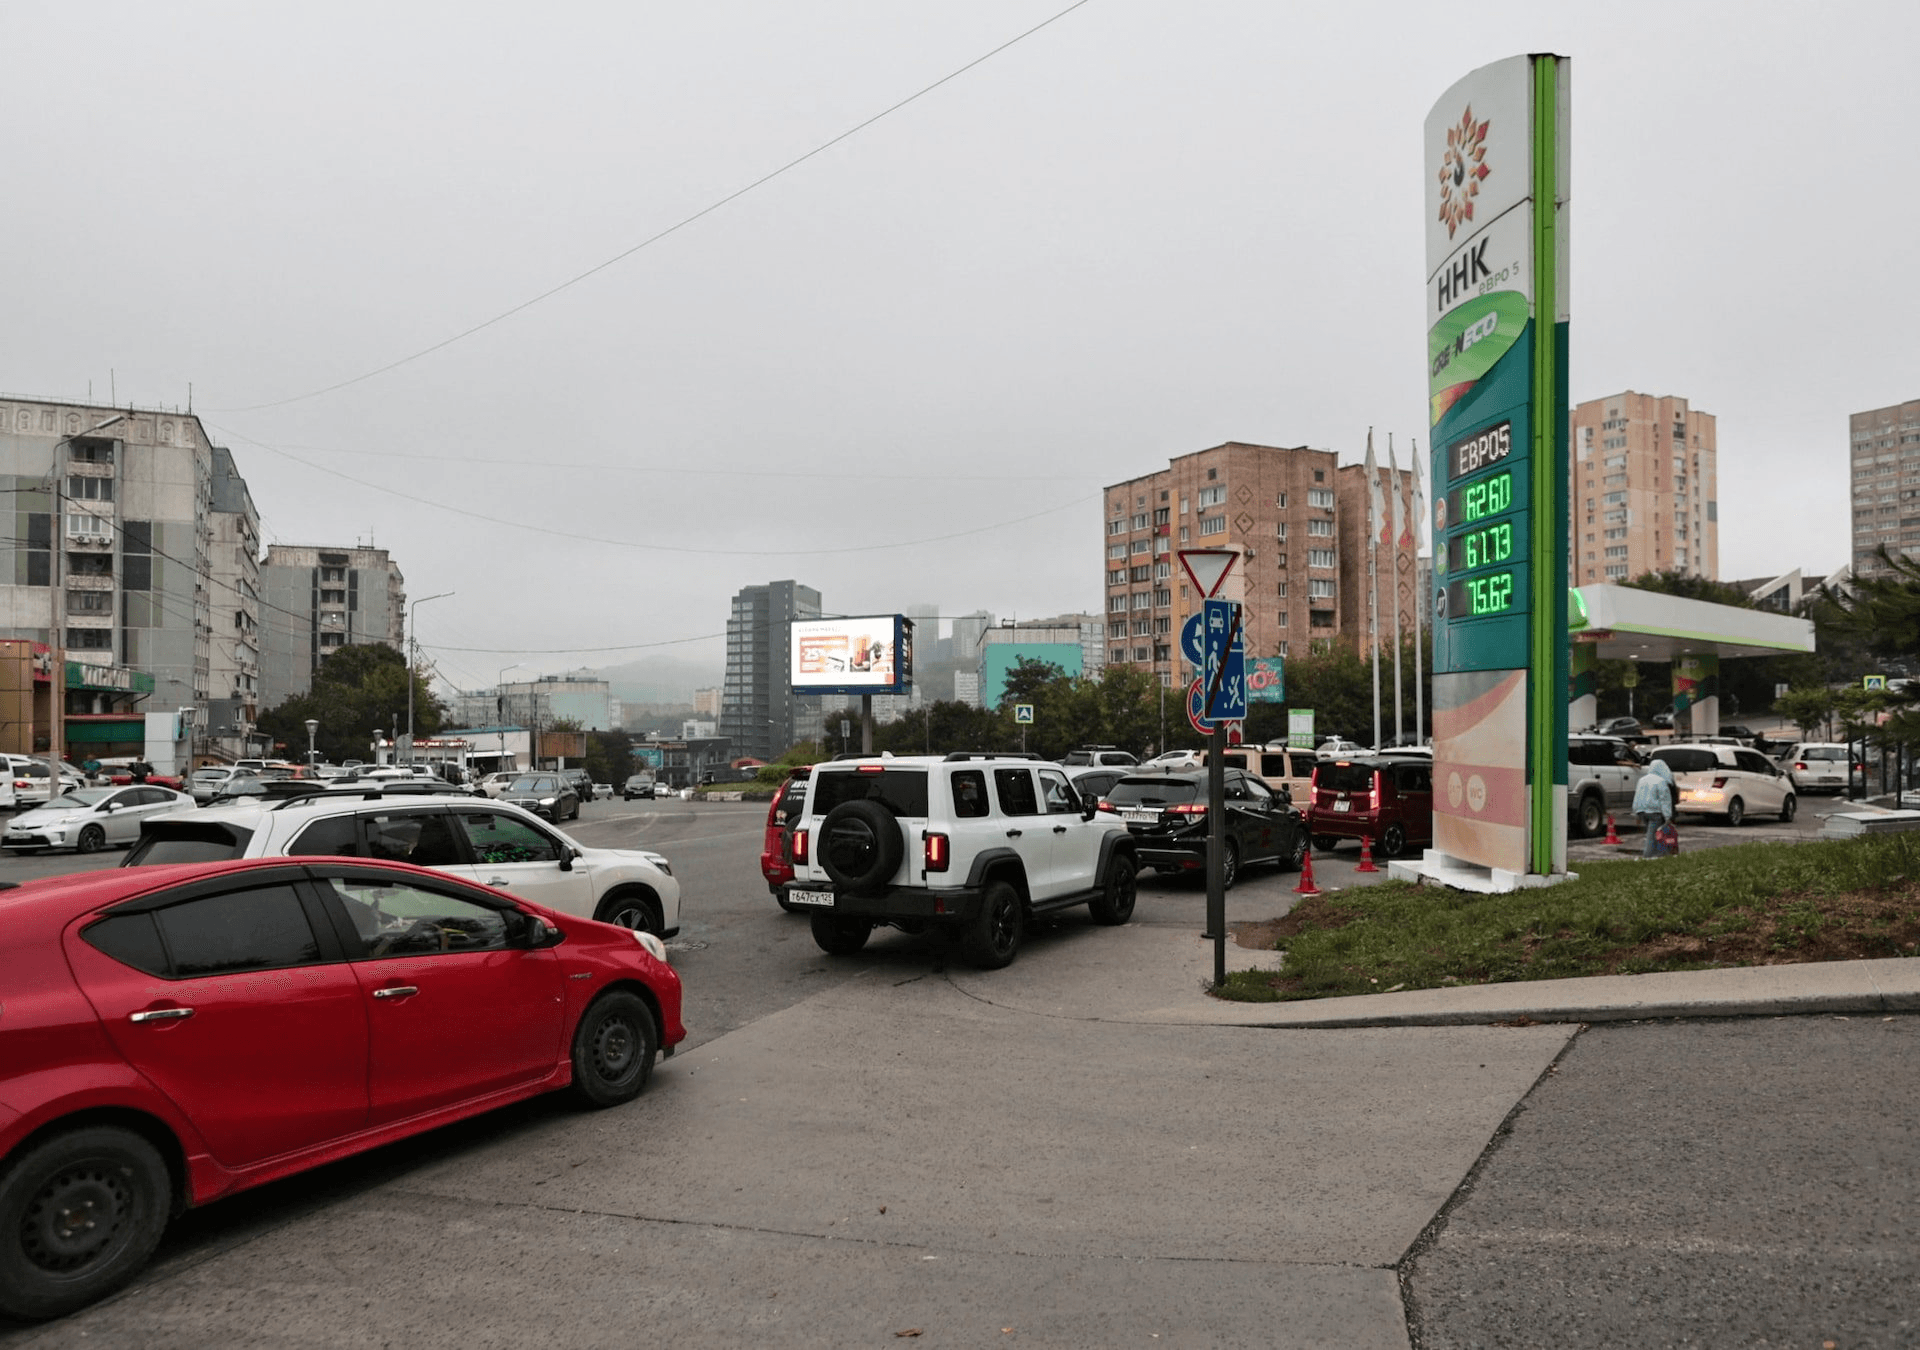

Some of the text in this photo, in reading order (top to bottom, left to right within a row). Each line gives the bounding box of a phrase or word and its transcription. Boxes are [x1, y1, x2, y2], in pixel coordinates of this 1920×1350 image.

[1438, 236, 1492, 312] ННК
[1513, 260, 1520, 276] 5
[1466, 523, 1511, 568] 61.73
[1247, 670, 1281, 691] 10%
